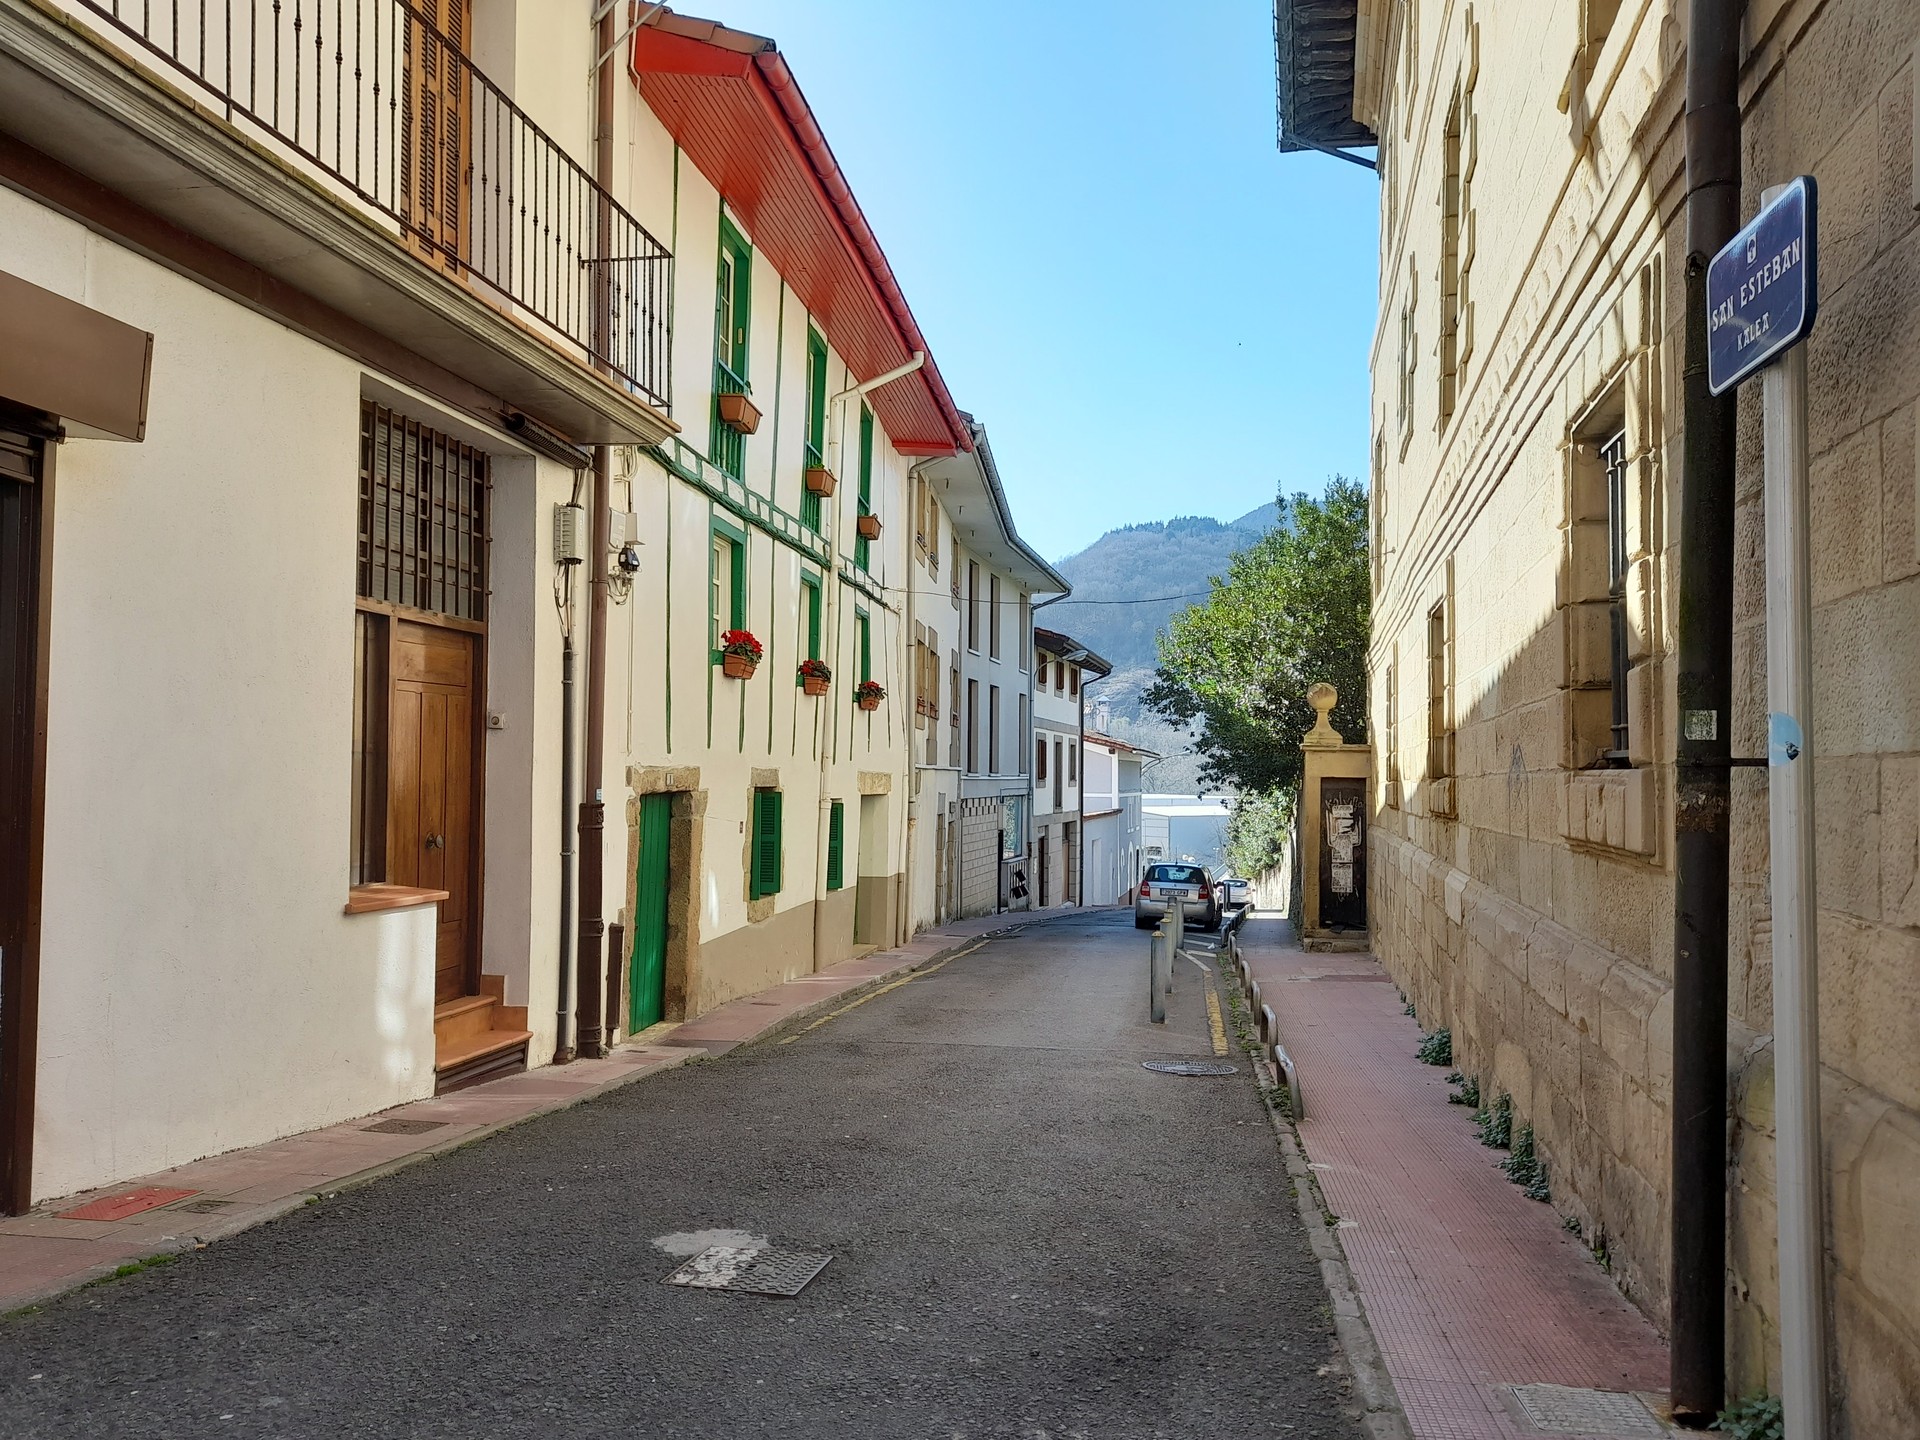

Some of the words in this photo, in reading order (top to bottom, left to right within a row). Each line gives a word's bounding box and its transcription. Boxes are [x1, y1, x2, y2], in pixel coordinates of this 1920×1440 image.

[1711, 294, 1734, 333] SAN
[1739, 236, 1801, 309] ESTEBAN
[1736, 312, 1770, 352] KALEA
